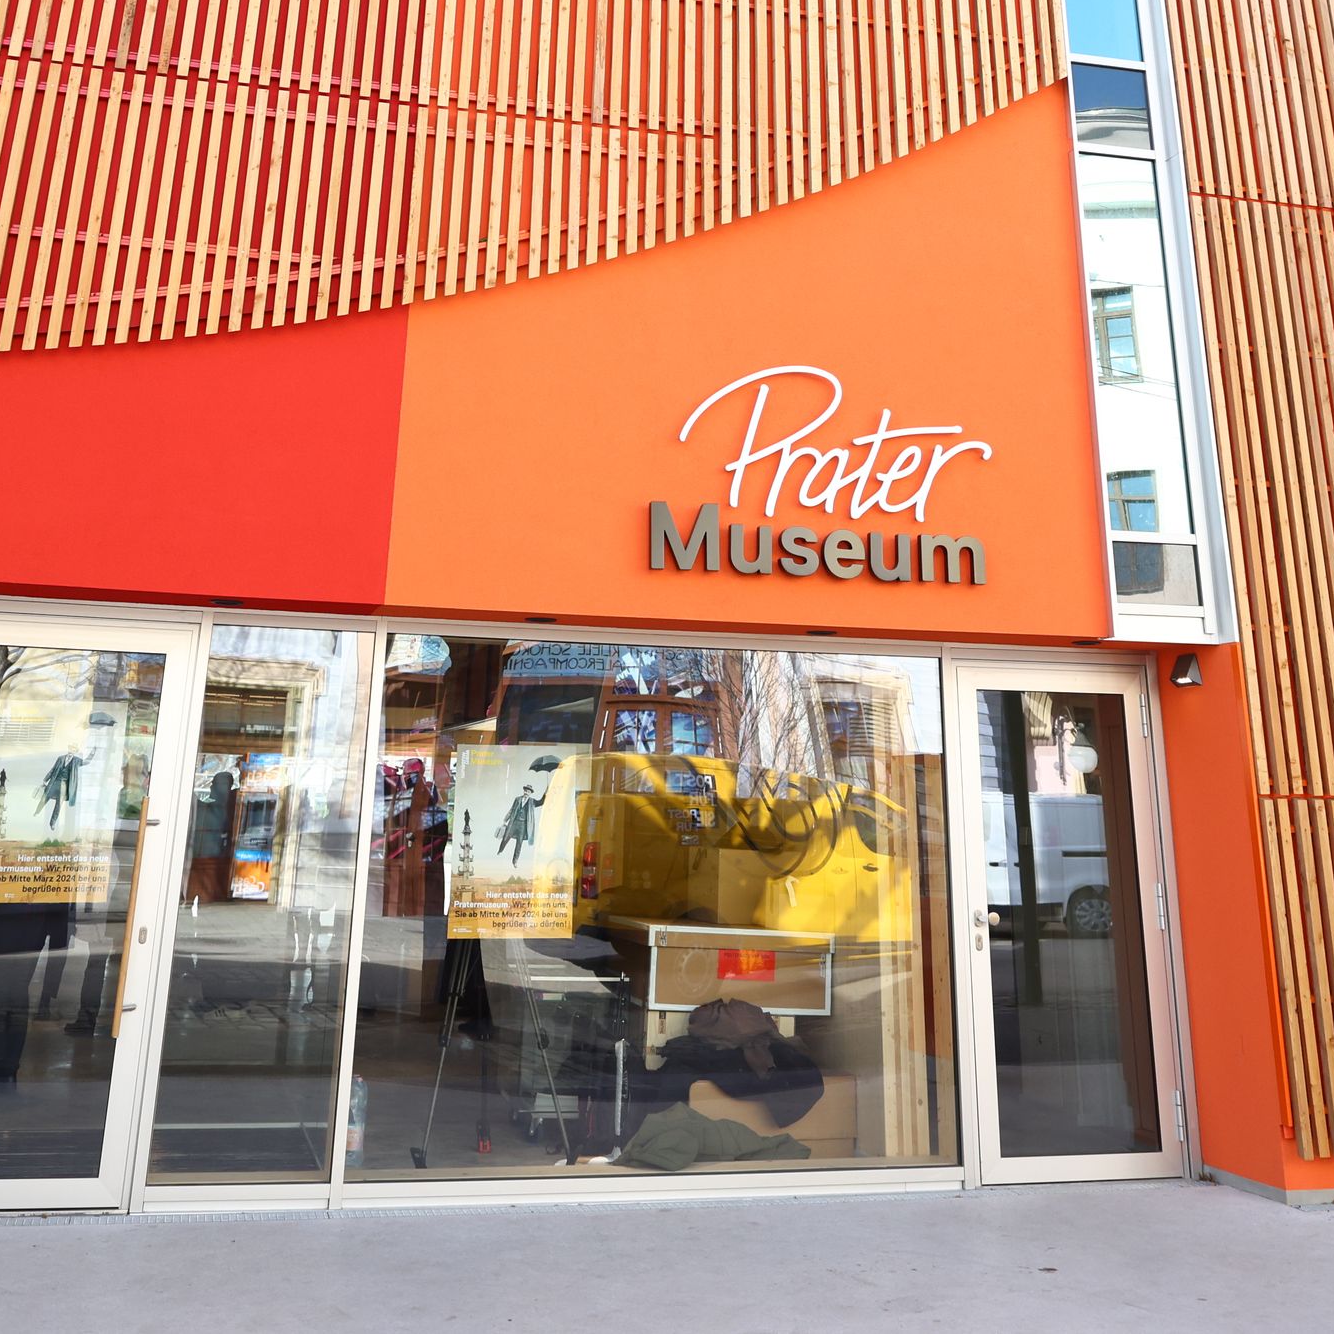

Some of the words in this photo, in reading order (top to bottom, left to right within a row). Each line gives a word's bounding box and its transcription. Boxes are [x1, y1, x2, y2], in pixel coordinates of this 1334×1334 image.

[679, 365, 993, 523] Prater
[649, 501, 987, 585] Museum
[17, 853, 35, 862] Hier
[37, 854, 72, 862] entsteht
[46, 864, 61, 872] Wir
[8, 874, 31, 883] Mitte
[56, 874, 76, 883] 2024
[22, 884, 62, 894] begrüßen
[63, 885, 73, 893] zu
[485, 890, 501, 899] Hier
[503, 891, 534, 899] entsteht
[455, 910, 467, 918] Sie
[468, 910, 478, 918] ab
[479, 910, 500, 918] Mitte
[541, 910, 553, 918] bei
[539, 921, 567, 929] dürfen!
